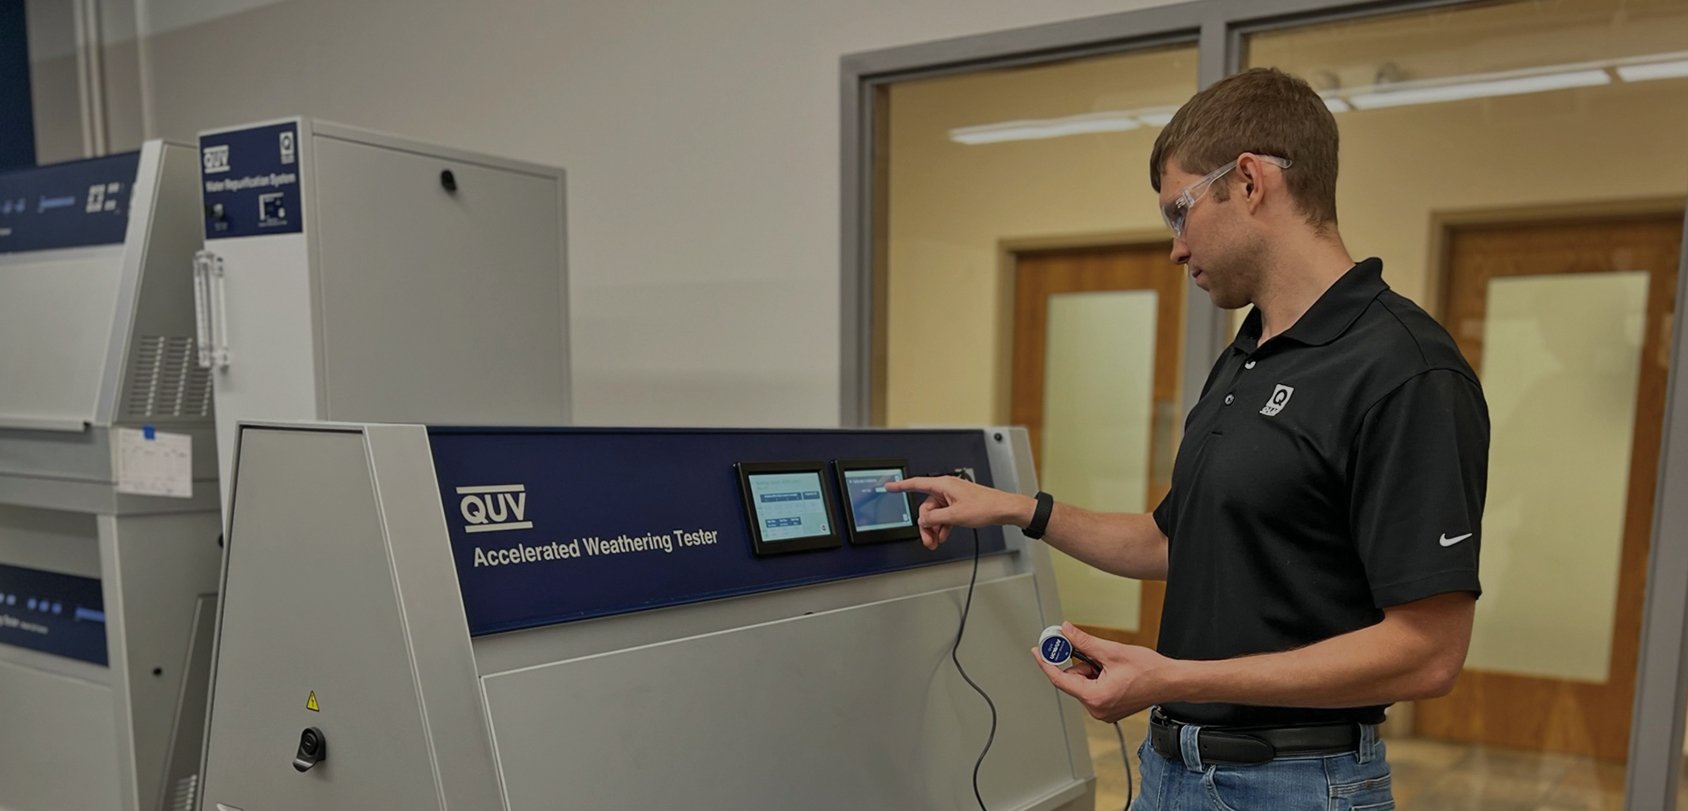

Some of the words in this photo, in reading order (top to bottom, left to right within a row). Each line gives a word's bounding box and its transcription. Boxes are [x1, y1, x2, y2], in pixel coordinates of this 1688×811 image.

[204, 151, 229, 169] QUV
[1273, 389, 1287, 406] Q
[460, 492, 527, 525] QUV
[473, 538, 582, 568] Accelerated
[582, 531, 674, 554] Weathering
[673, 528, 719, 548] Tester
